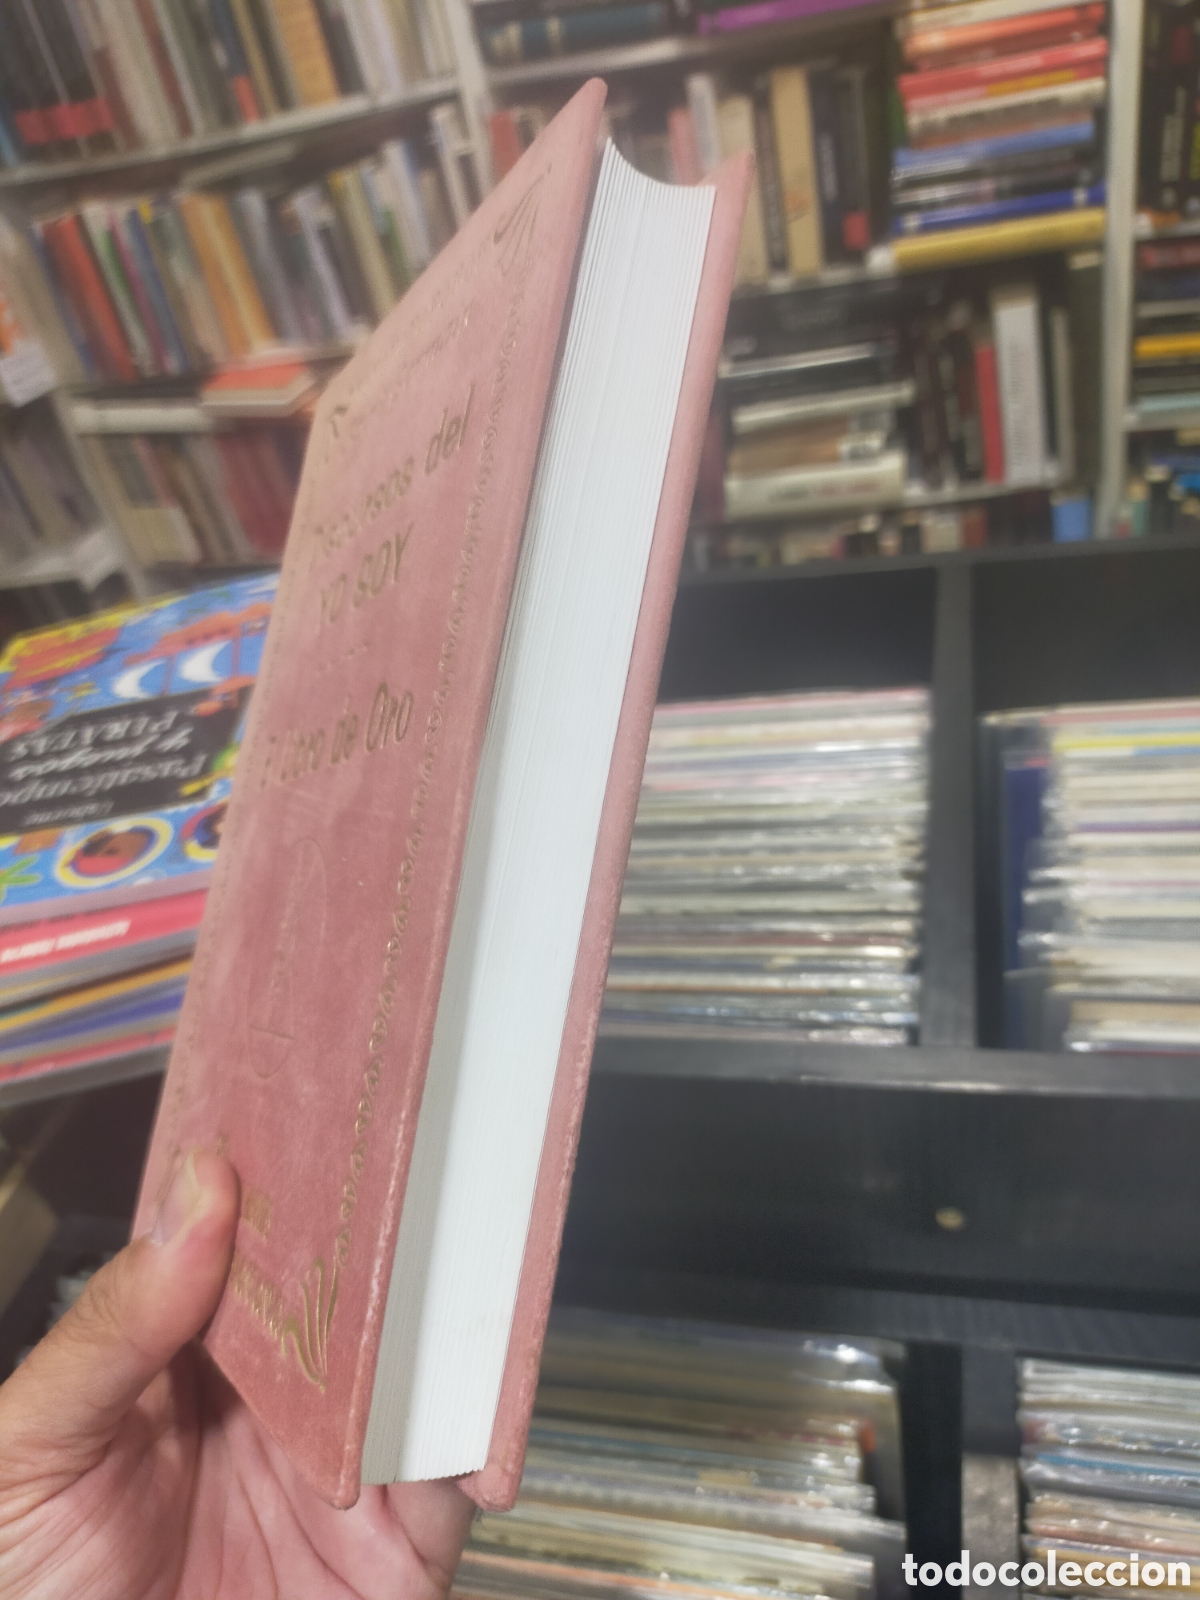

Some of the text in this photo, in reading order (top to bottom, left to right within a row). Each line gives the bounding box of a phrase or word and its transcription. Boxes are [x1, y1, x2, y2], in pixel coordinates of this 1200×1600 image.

[424, 383, 475, 476] del
[352, 521, 415, 608] SOY
[8, 709, 179, 763] PIRATAS
[366, 680, 415, 752] Oro
